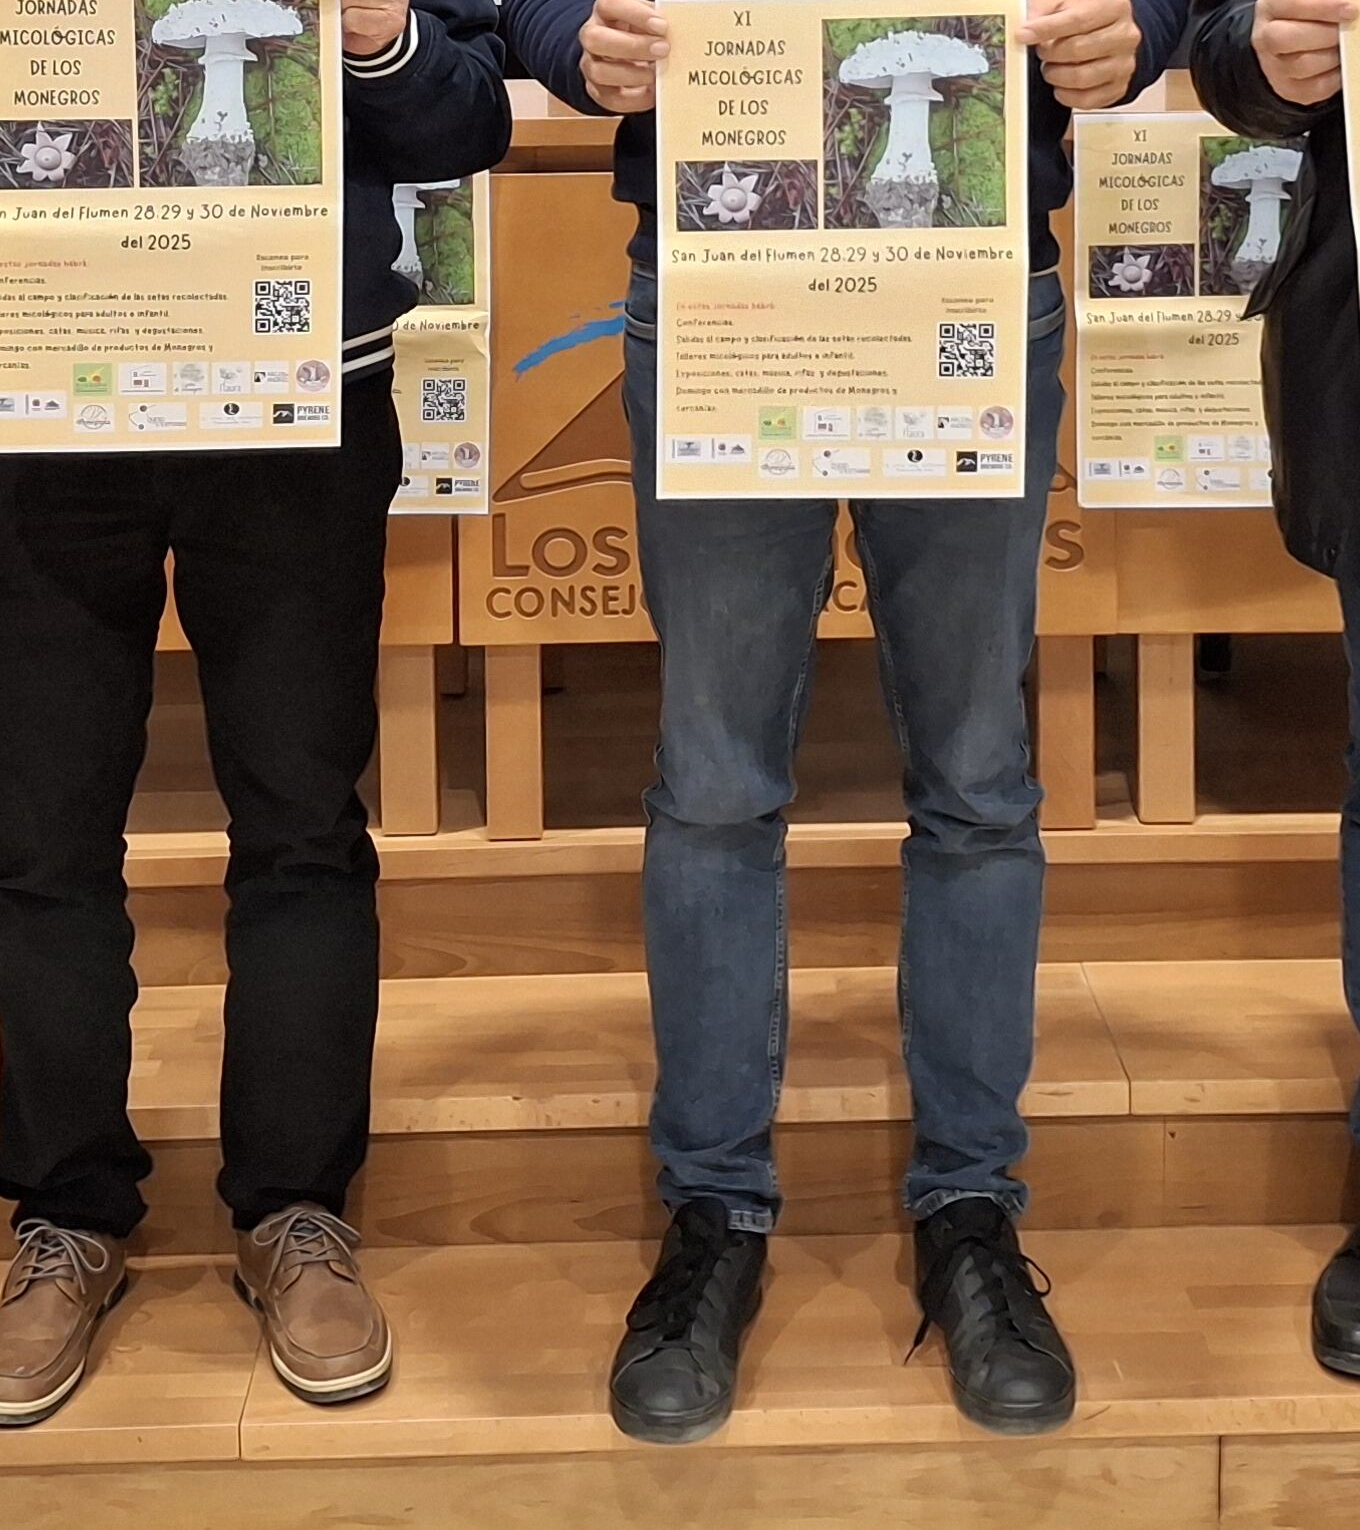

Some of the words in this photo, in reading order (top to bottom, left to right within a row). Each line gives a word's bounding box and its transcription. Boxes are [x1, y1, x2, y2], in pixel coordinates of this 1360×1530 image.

[733, 10, 751, 26] XI
[0, 25, 115, 45] MICOLÓGICAS
[703, 39, 785, 56] JORNADAS
[30, 59, 47, 76] DE
[52, 59, 81, 76] LOS
[688, 66, 802, 86] MICOLÓGICAS
[14, 89, 100, 106] MONEGROS
[718, 99, 734, 116] DE
[740, 99, 768, 115] LOS
[701, 129, 786, 146] MONEGROS
[1133, 129, 1147, 142] XI
[1111, 151, 1173, 165] JORNADAS
[12, 206, 46, 220] Juan
[52, 206, 74, 219] del
[78, 205, 128, 220] Flumen
[186, 208, 194, 220] y
[199, 203, 223, 219] 30
[228, 204, 245, 217] de
[250, 203, 328, 219] Noviembre
[1137, 198, 1159, 211] LOS
[1108, 220, 1172, 234] MONEGROS
[120, 235, 142, 249] del
[147, 233, 191, 250] 2025
[671, 249, 695, 263] San
[701, 248, 735, 263] Juan
[740, 248, 761, 261] del
[765, 247, 814, 263] Flumen
[872, 251, 879, 263] y
[885, 245, 908, 262] 30
[913, 246, 930, 260] de
[935, 245, 1013, 261] Noviembre
[808, 278, 829, 291] del
[834, 276, 877, 293] 2025
[403, 320, 417, 331] de
[419, 319, 481, 332] Noviembre
[1086, 312, 1106, 325] San
[1110, 311, 1134, 324] Juan
[1138, 311, 1154, 322] del
[1157, 310, 1194, 323] Flumen
[1188, 334, 1205, 344] del
[1207, 332, 1239, 346] 2025
[296, 405, 329, 414] PYRENE
[486, 584, 644, 619] CONSEJ
